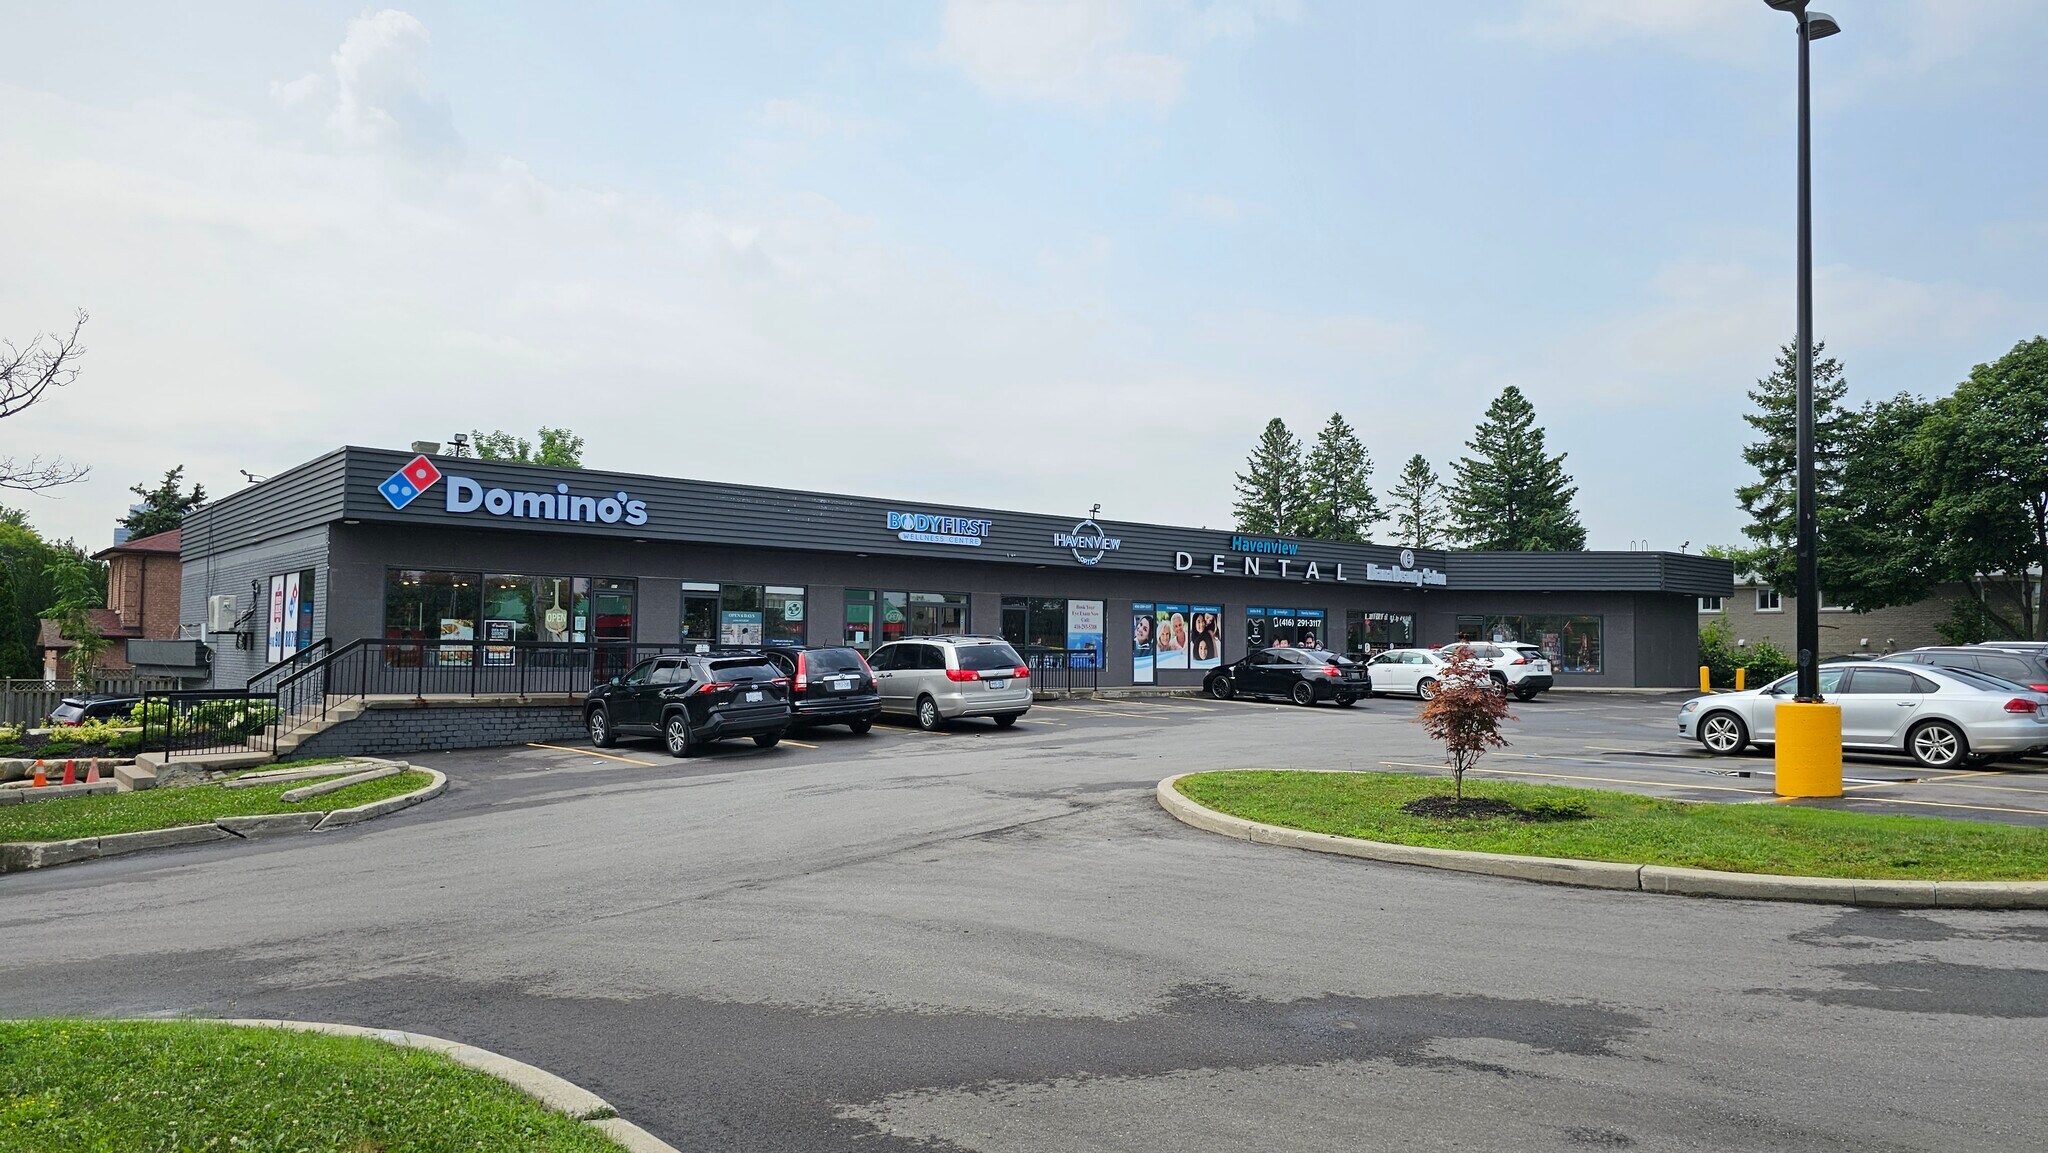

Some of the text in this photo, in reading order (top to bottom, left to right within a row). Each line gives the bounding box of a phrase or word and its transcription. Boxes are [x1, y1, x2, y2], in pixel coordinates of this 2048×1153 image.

[446, 475, 648, 526] Domino's
[887, 511, 991, 537] BODYFIRST
[903, 533, 979, 545] WELLNESS CENTRE
[1232, 536, 1298, 555] Havenview
[1079, 556, 1099, 566] OPTICS
[1175, 551, 1347, 582] DENTAL
[547, 613, 567, 623] OPEN
[1279, 618, 1294, 627] (416)
